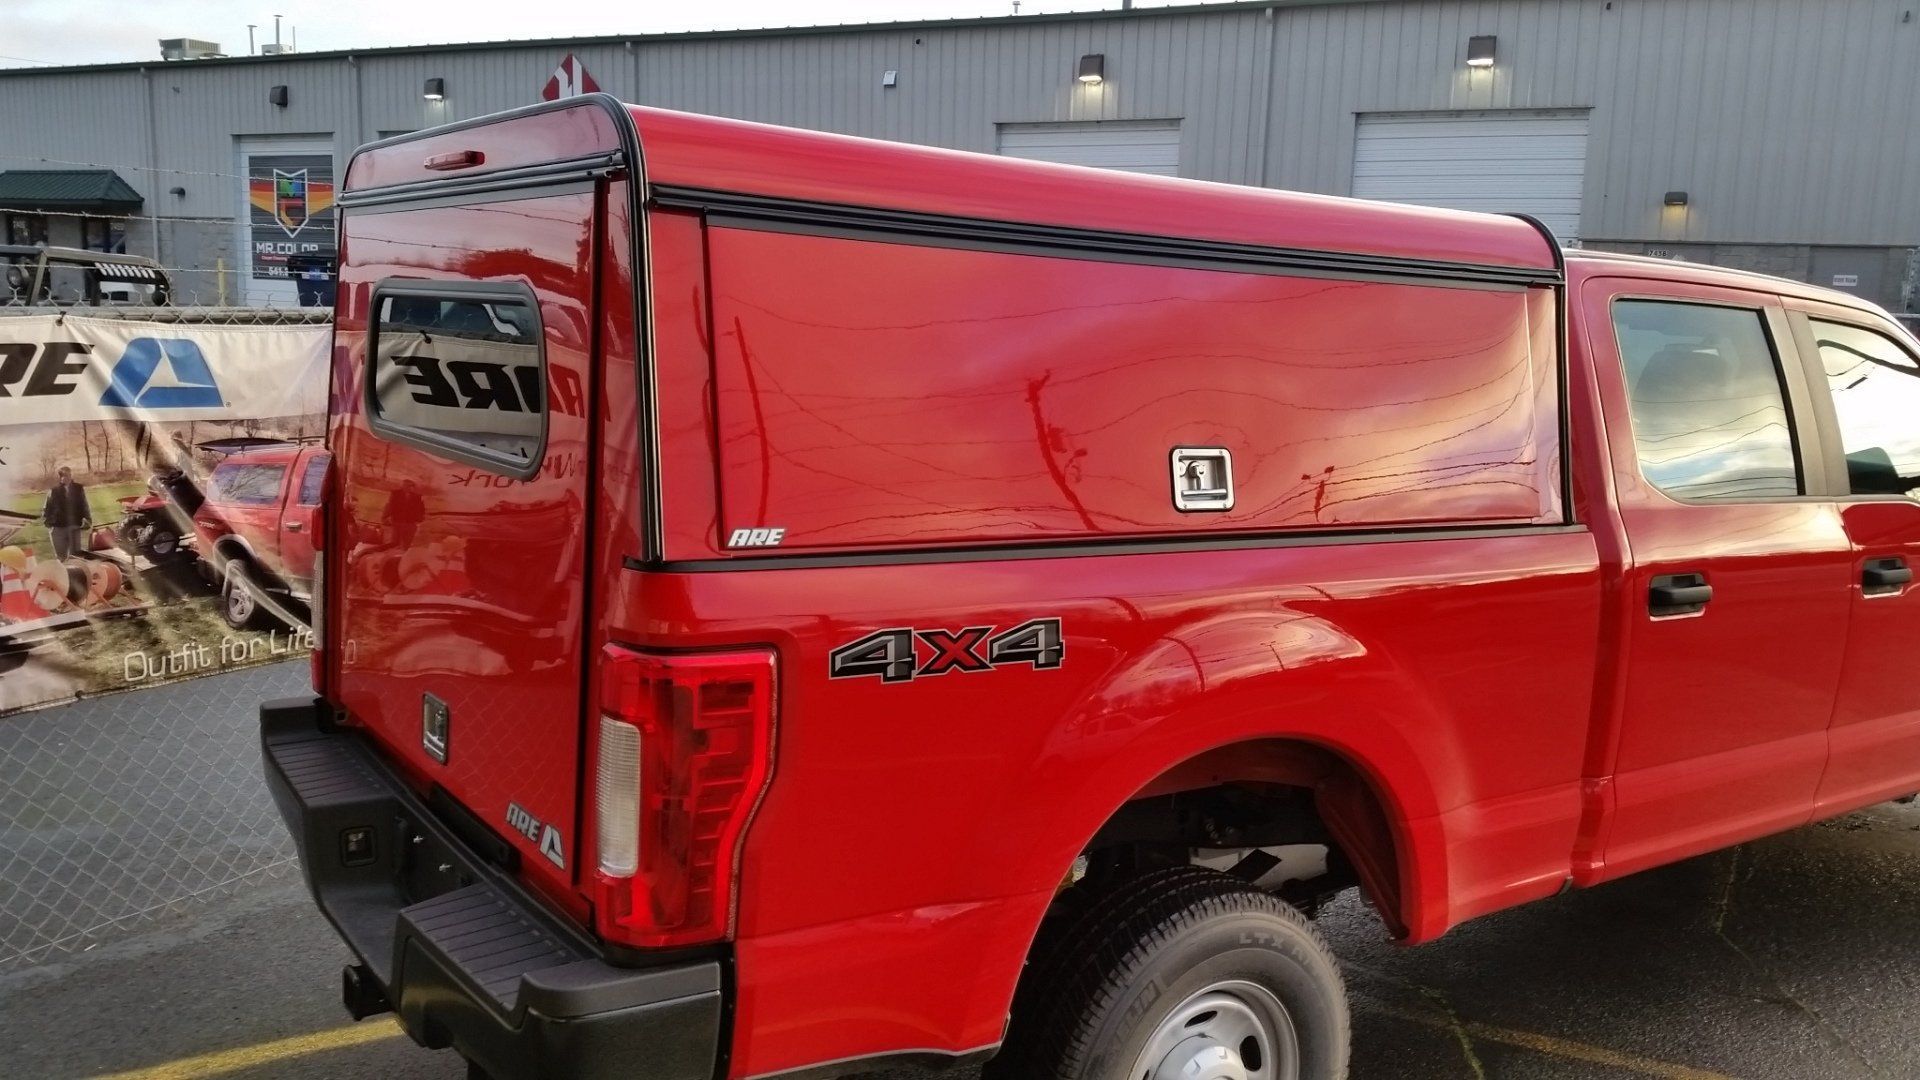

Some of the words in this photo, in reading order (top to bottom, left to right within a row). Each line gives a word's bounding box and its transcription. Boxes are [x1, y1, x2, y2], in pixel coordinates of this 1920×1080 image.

[727, 528, 785, 547] ARE
[124, 646, 210, 682] Outfit
[220, 636, 264, 664] for
[270, 625, 314, 655] Life
[506, 802, 541, 842] ARE
